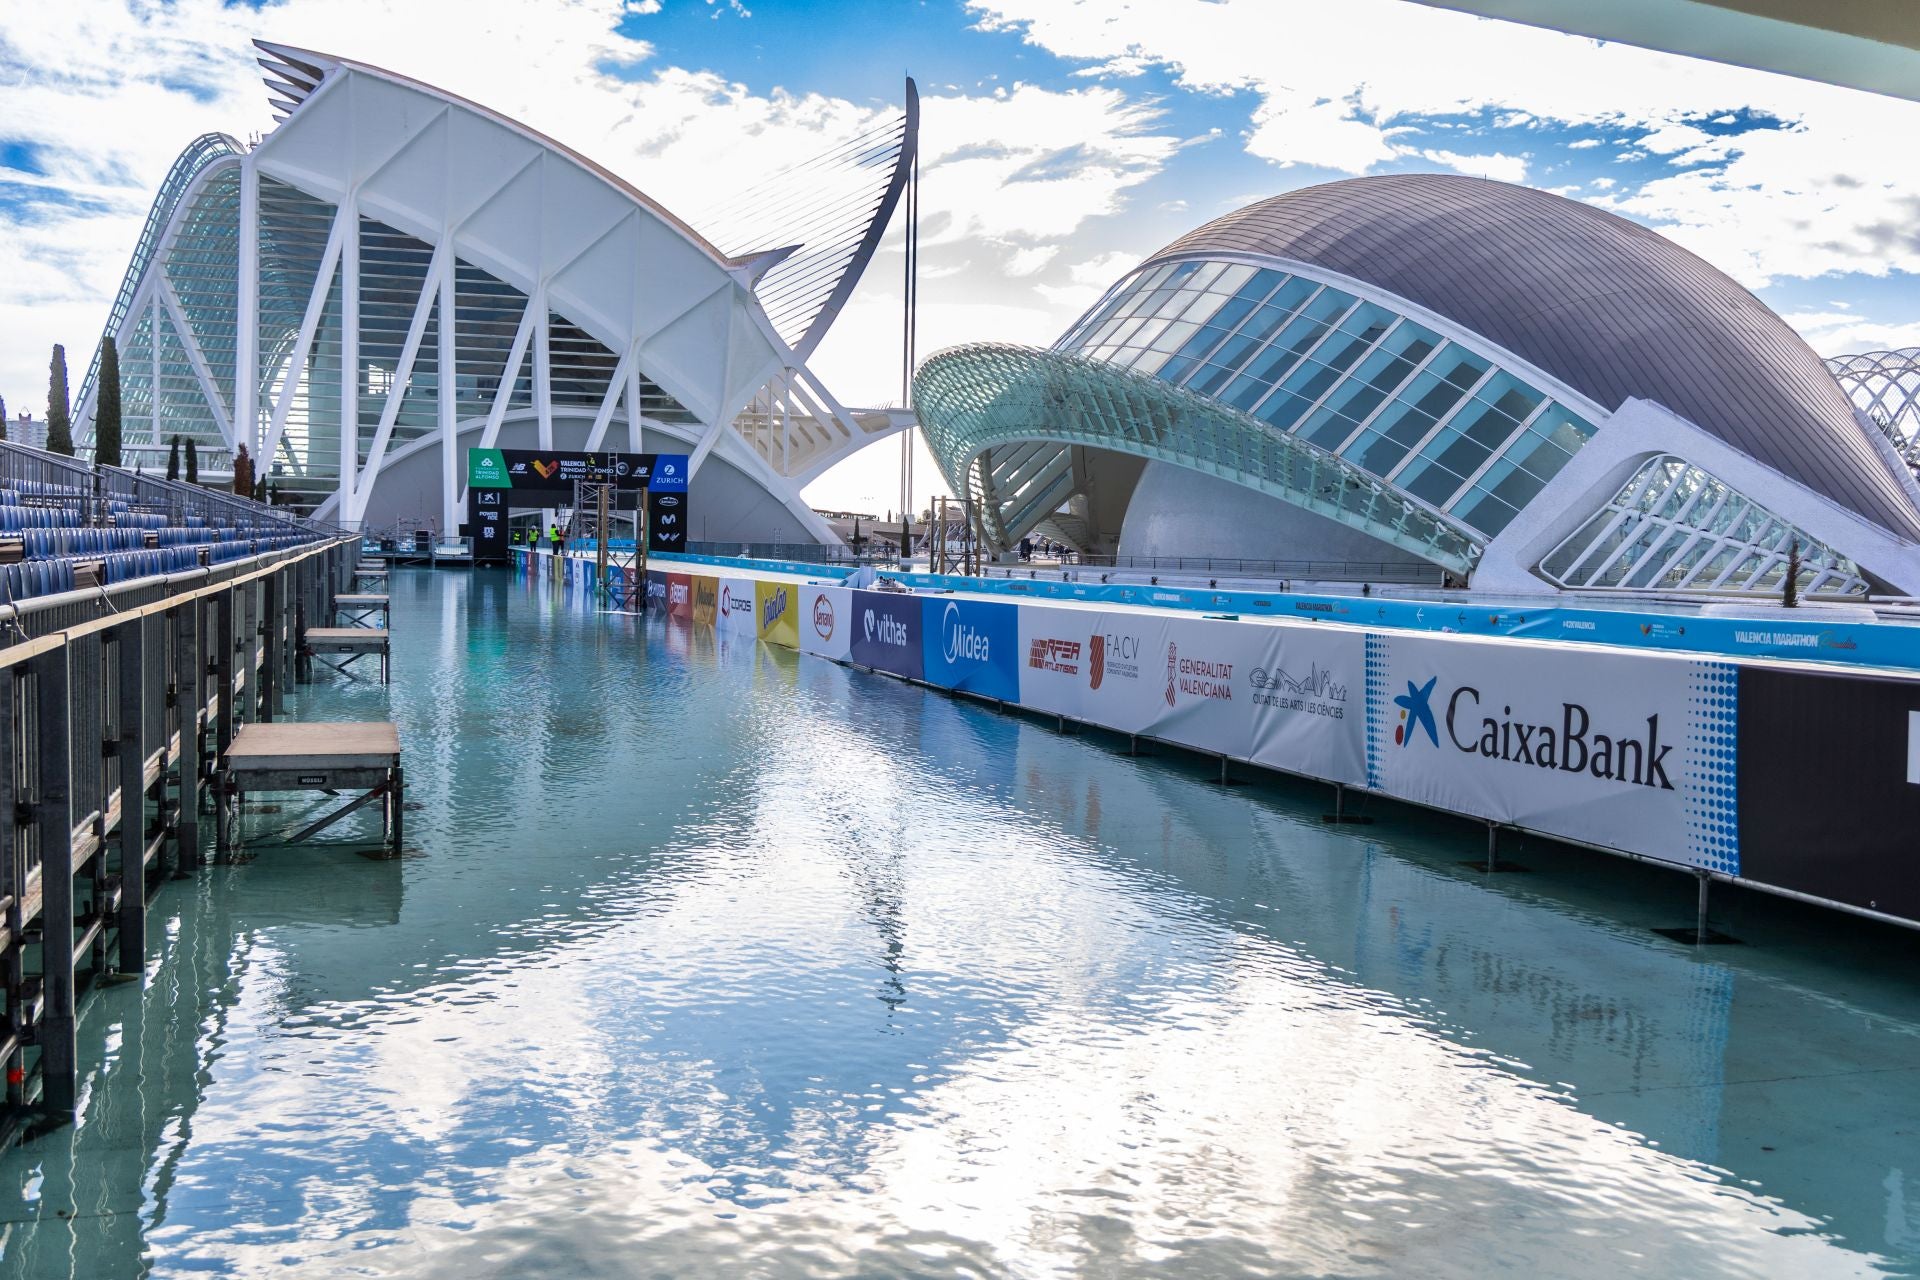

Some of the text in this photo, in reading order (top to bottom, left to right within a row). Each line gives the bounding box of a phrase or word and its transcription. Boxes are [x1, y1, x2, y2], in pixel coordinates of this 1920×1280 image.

[731, 598, 751, 612] COROS
[815, 606, 832, 628] Serrano
[876, 614, 907, 647] vithas
[943, 601, 990, 665] Midea
[1734, 630, 1772, 645] VALENCIA
[1773, 632, 1819, 647] MARATHON
[1106, 634, 1140, 660] FACV
[1044, 660, 1078, 675] ATLETISMO
[1179, 658, 1233, 680] GENERALITAT
[1179, 678, 1232, 701] VALENCIANA
[1252, 693, 1271, 706] CIUTAT
[1272, 696, 1280, 707] DE
[1280, 697, 1289, 709] LES
[1289, 698, 1304, 712] ARTS
[1307, 702, 1317, 714] LES
[1317, 702, 1344, 720] CIÈNCIES
[1446, 686, 1675, 791] CaixaBank
